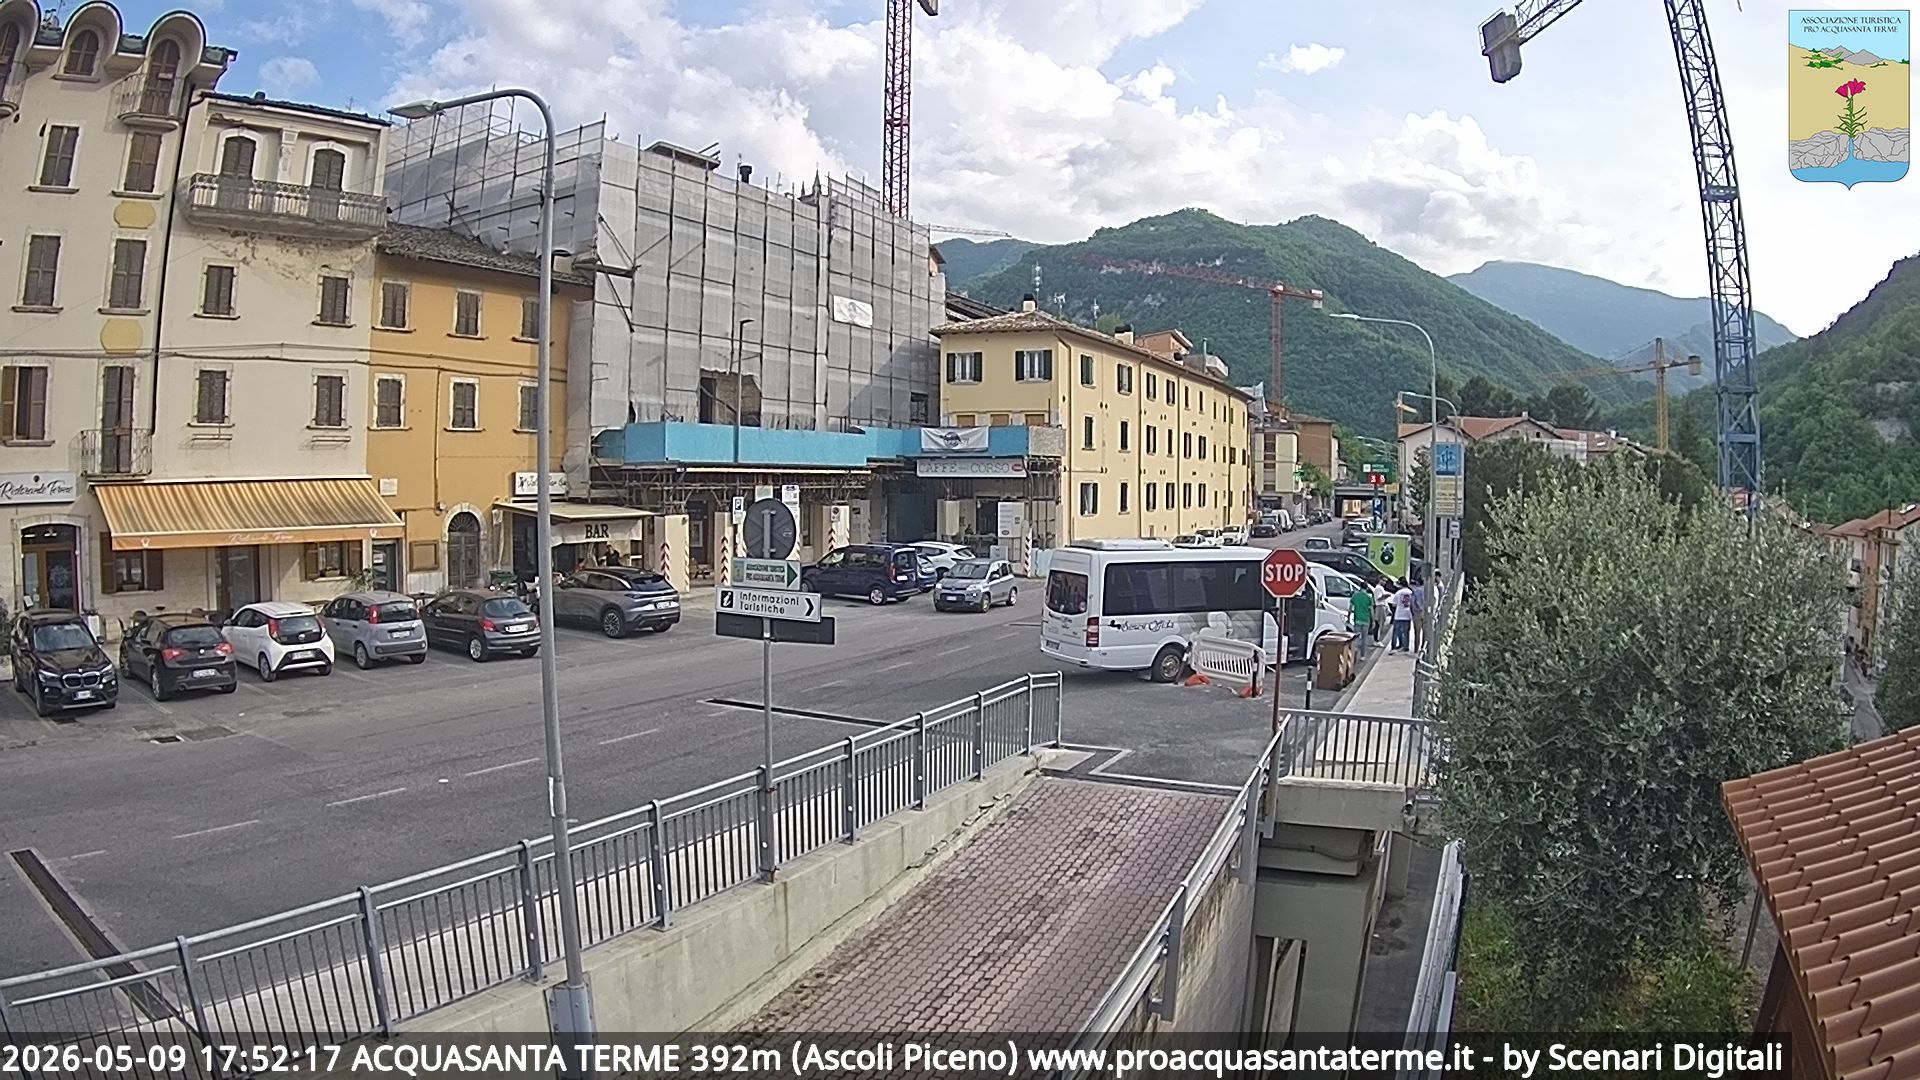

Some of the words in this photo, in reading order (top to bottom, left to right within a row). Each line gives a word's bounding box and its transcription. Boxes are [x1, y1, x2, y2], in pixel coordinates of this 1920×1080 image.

[970, 462, 1009, 473] CORSO
[585, 523, 609, 539] BAR
[1265, 563, 1304, 582] STOP
[740, 591, 800, 606] Informazioni
[740, 601, 785, 615] Turistiche
